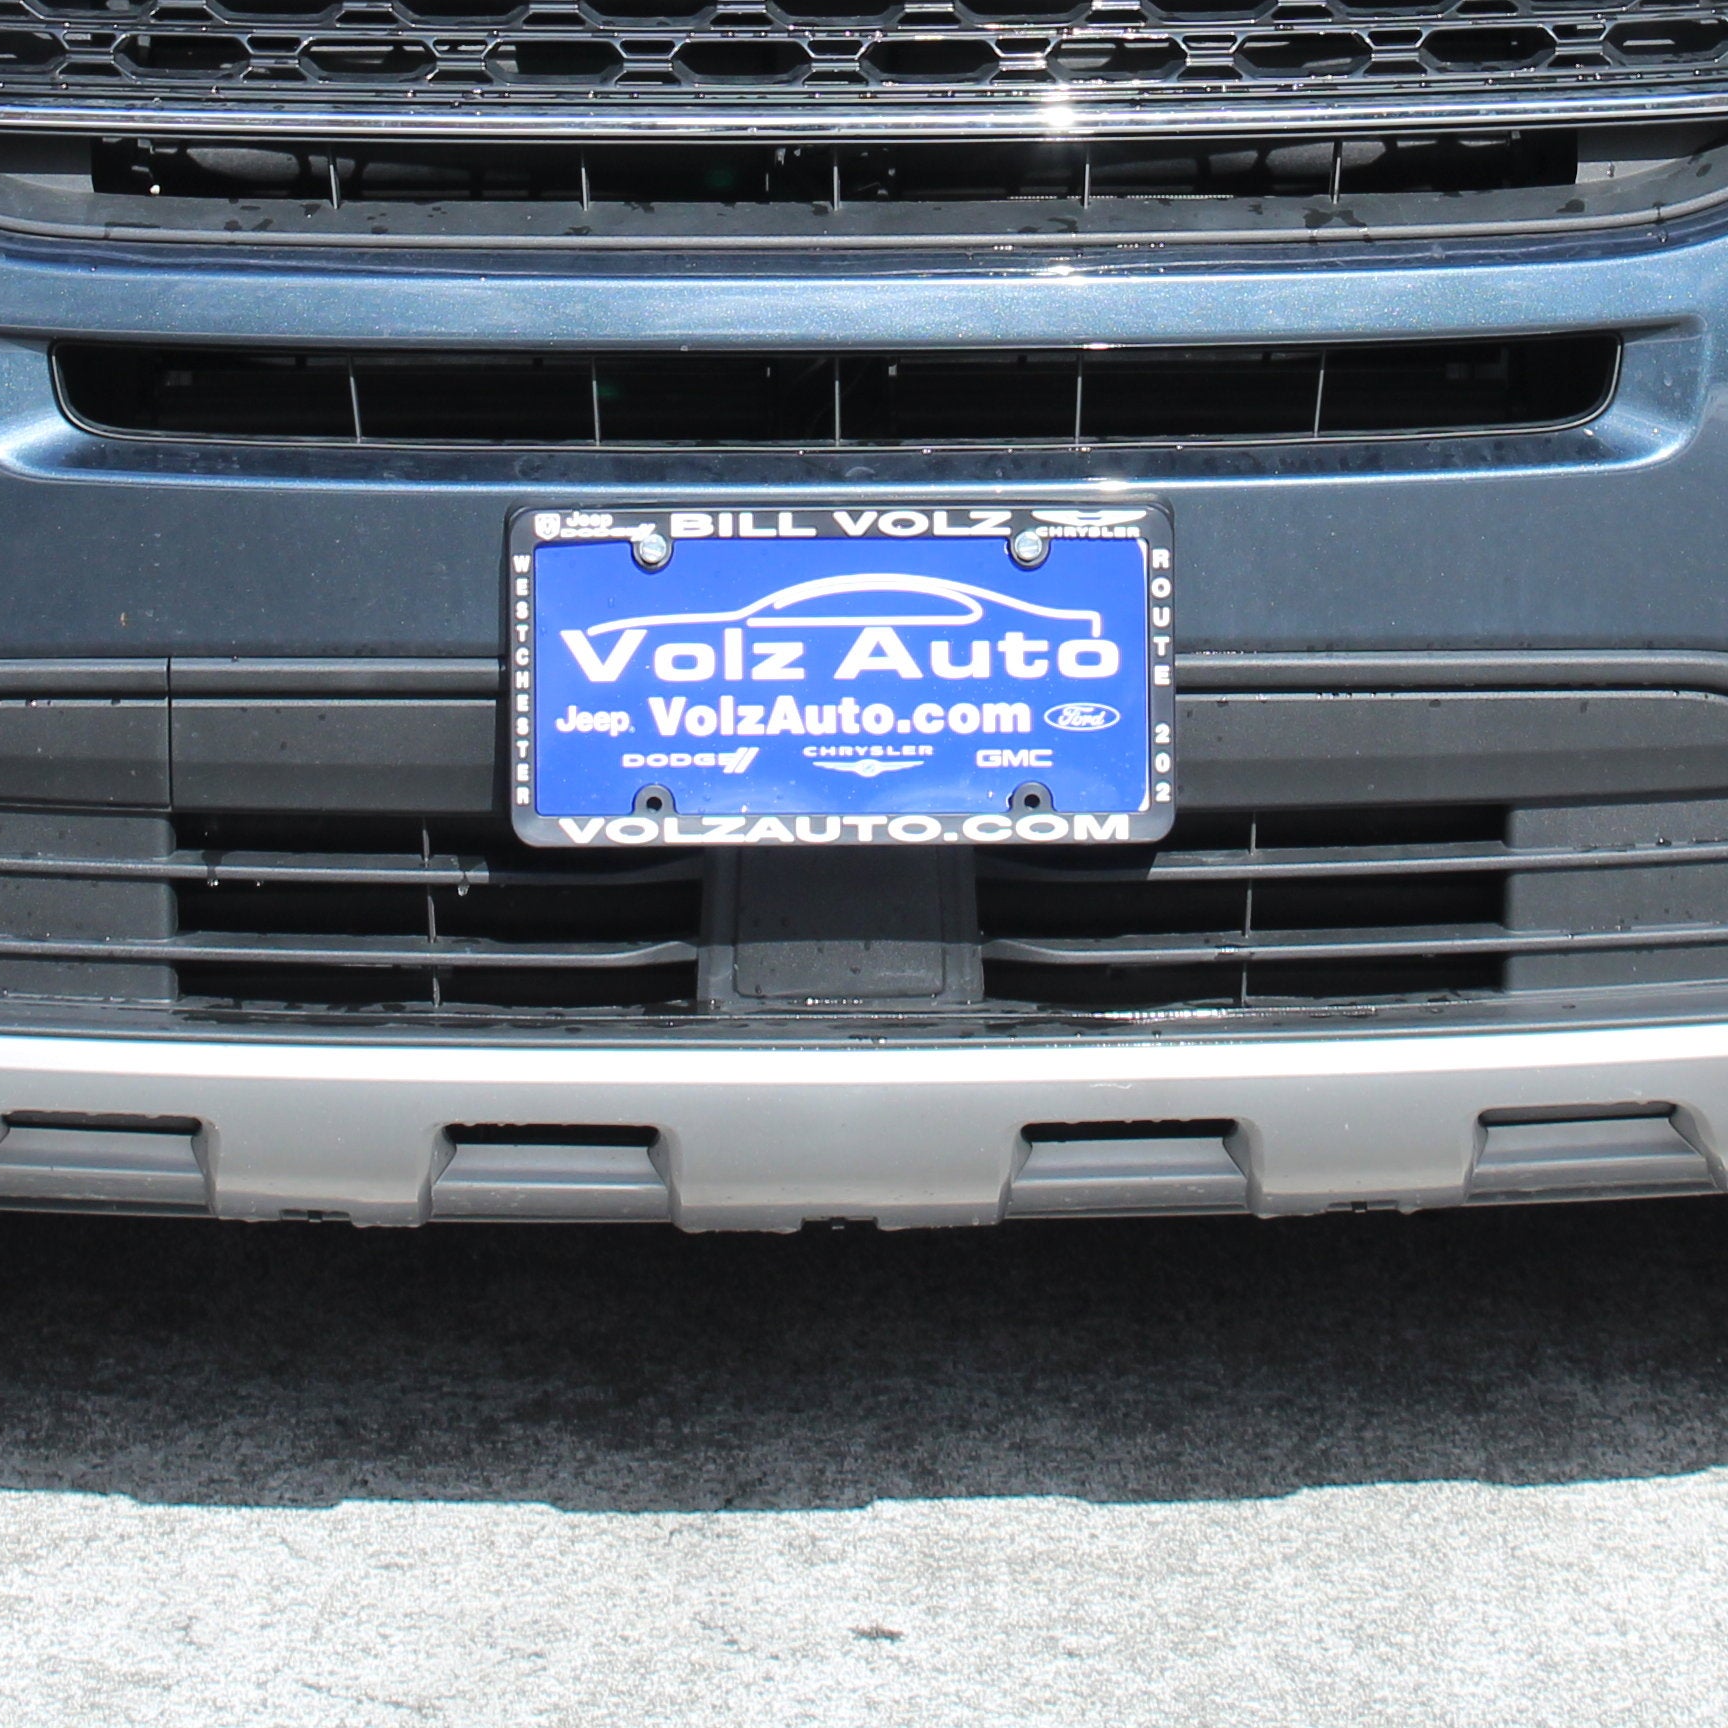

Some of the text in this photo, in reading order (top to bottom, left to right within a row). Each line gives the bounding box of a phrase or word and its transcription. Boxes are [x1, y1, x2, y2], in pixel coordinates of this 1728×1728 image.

[566, 511, 613, 528] Jeep
[670, 510, 1012, 538] BILL VOLZ
[1035, 526, 1141, 539] CHRYSLER
[560, 626, 1120, 683] Volz Auto
[512, 555, 531, 806] WESTCHESTER
[1151, 549, 1171, 802] ROUTE 202
[556, 704, 630, 737] Jeep
[648, 695, 1032, 736] VolzAuto.com
[1057, 705, 1105, 727] Ford
[622, 752, 737, 768] DODGE
[803, 744, 934, 757] CHRYSLER
[975, 749, 1054, 768] GMC
[558, 814, 1130, 844] VOLZAUTO.COM
